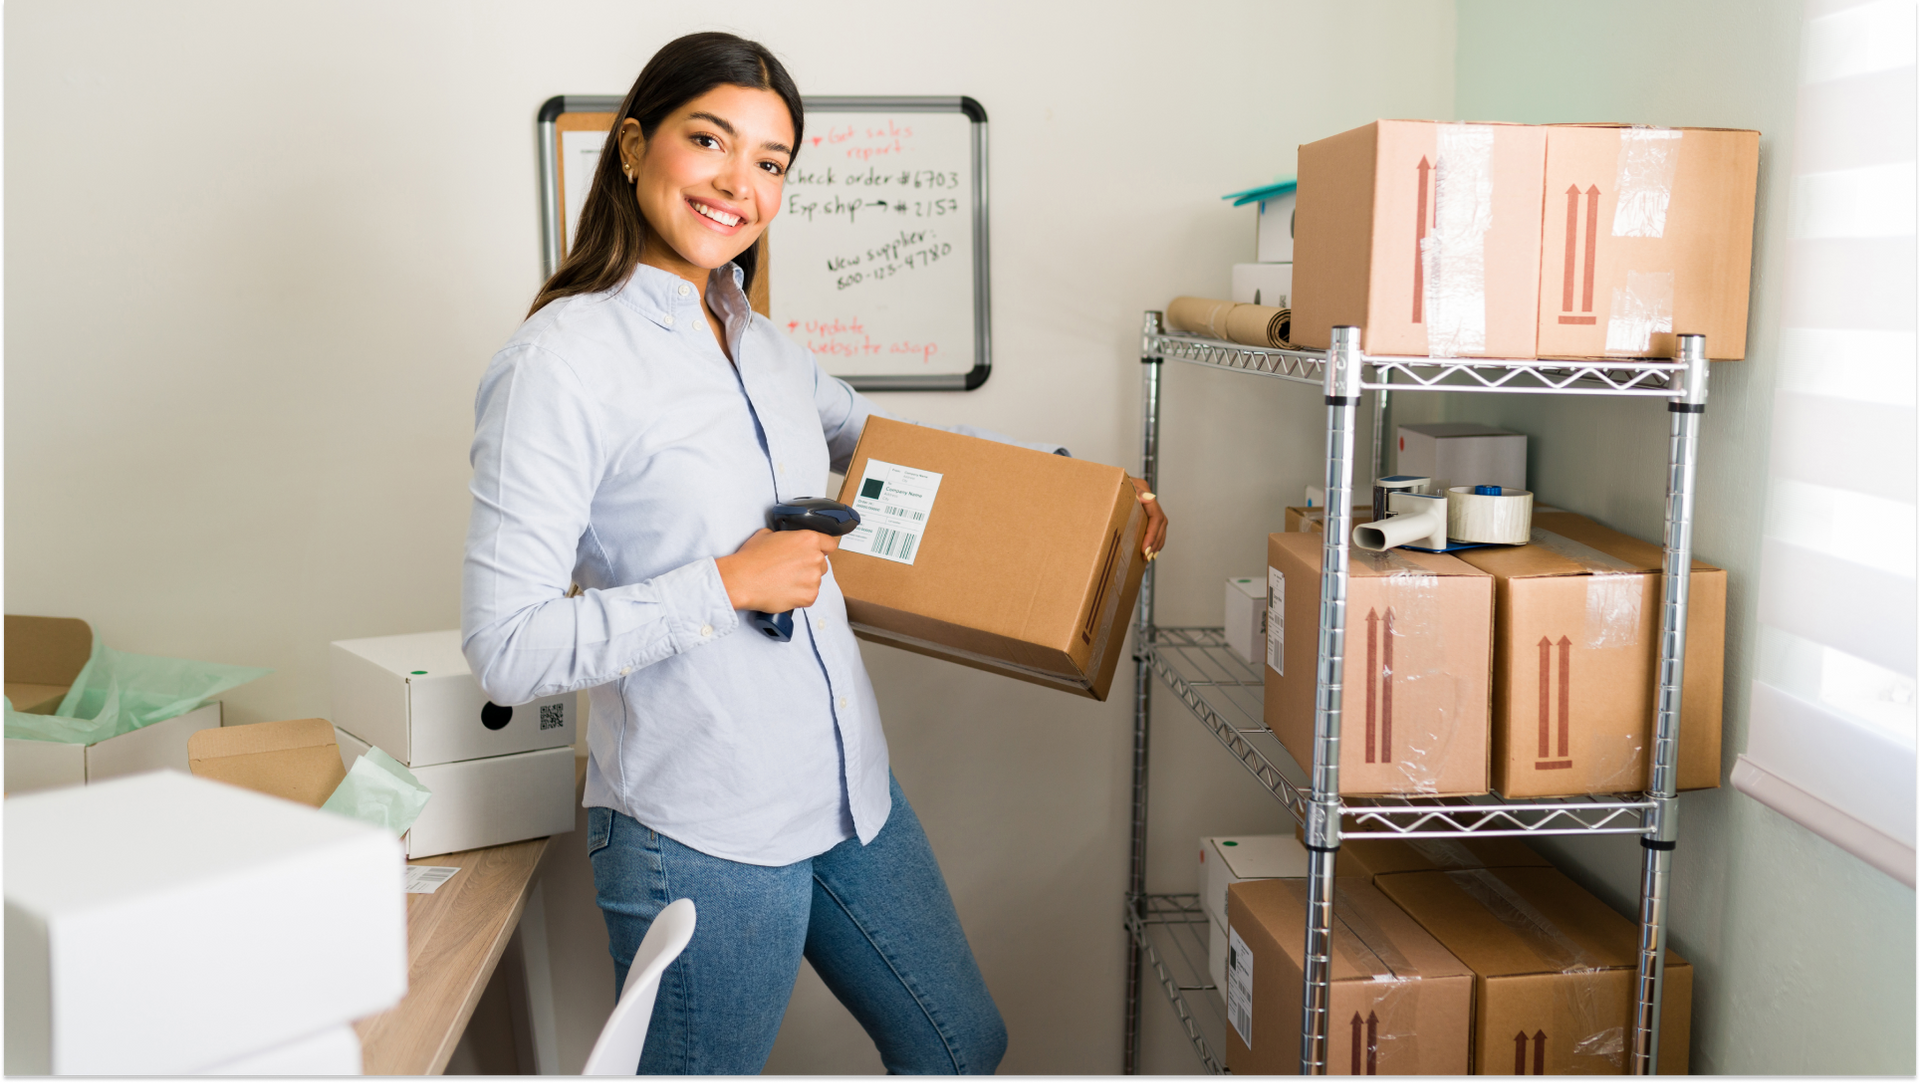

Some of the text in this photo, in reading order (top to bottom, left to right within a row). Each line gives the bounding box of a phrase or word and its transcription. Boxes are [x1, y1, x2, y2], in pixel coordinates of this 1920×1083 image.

[828, 119, 913, 144] Get sales
[786, 167, 836, 186] Check
[845, 166, 894, 186] order
[827, 230, 937, 272] New supplier:
[805, 316, 864, 337] Update
[885, 486, 923, 499] Company Name
